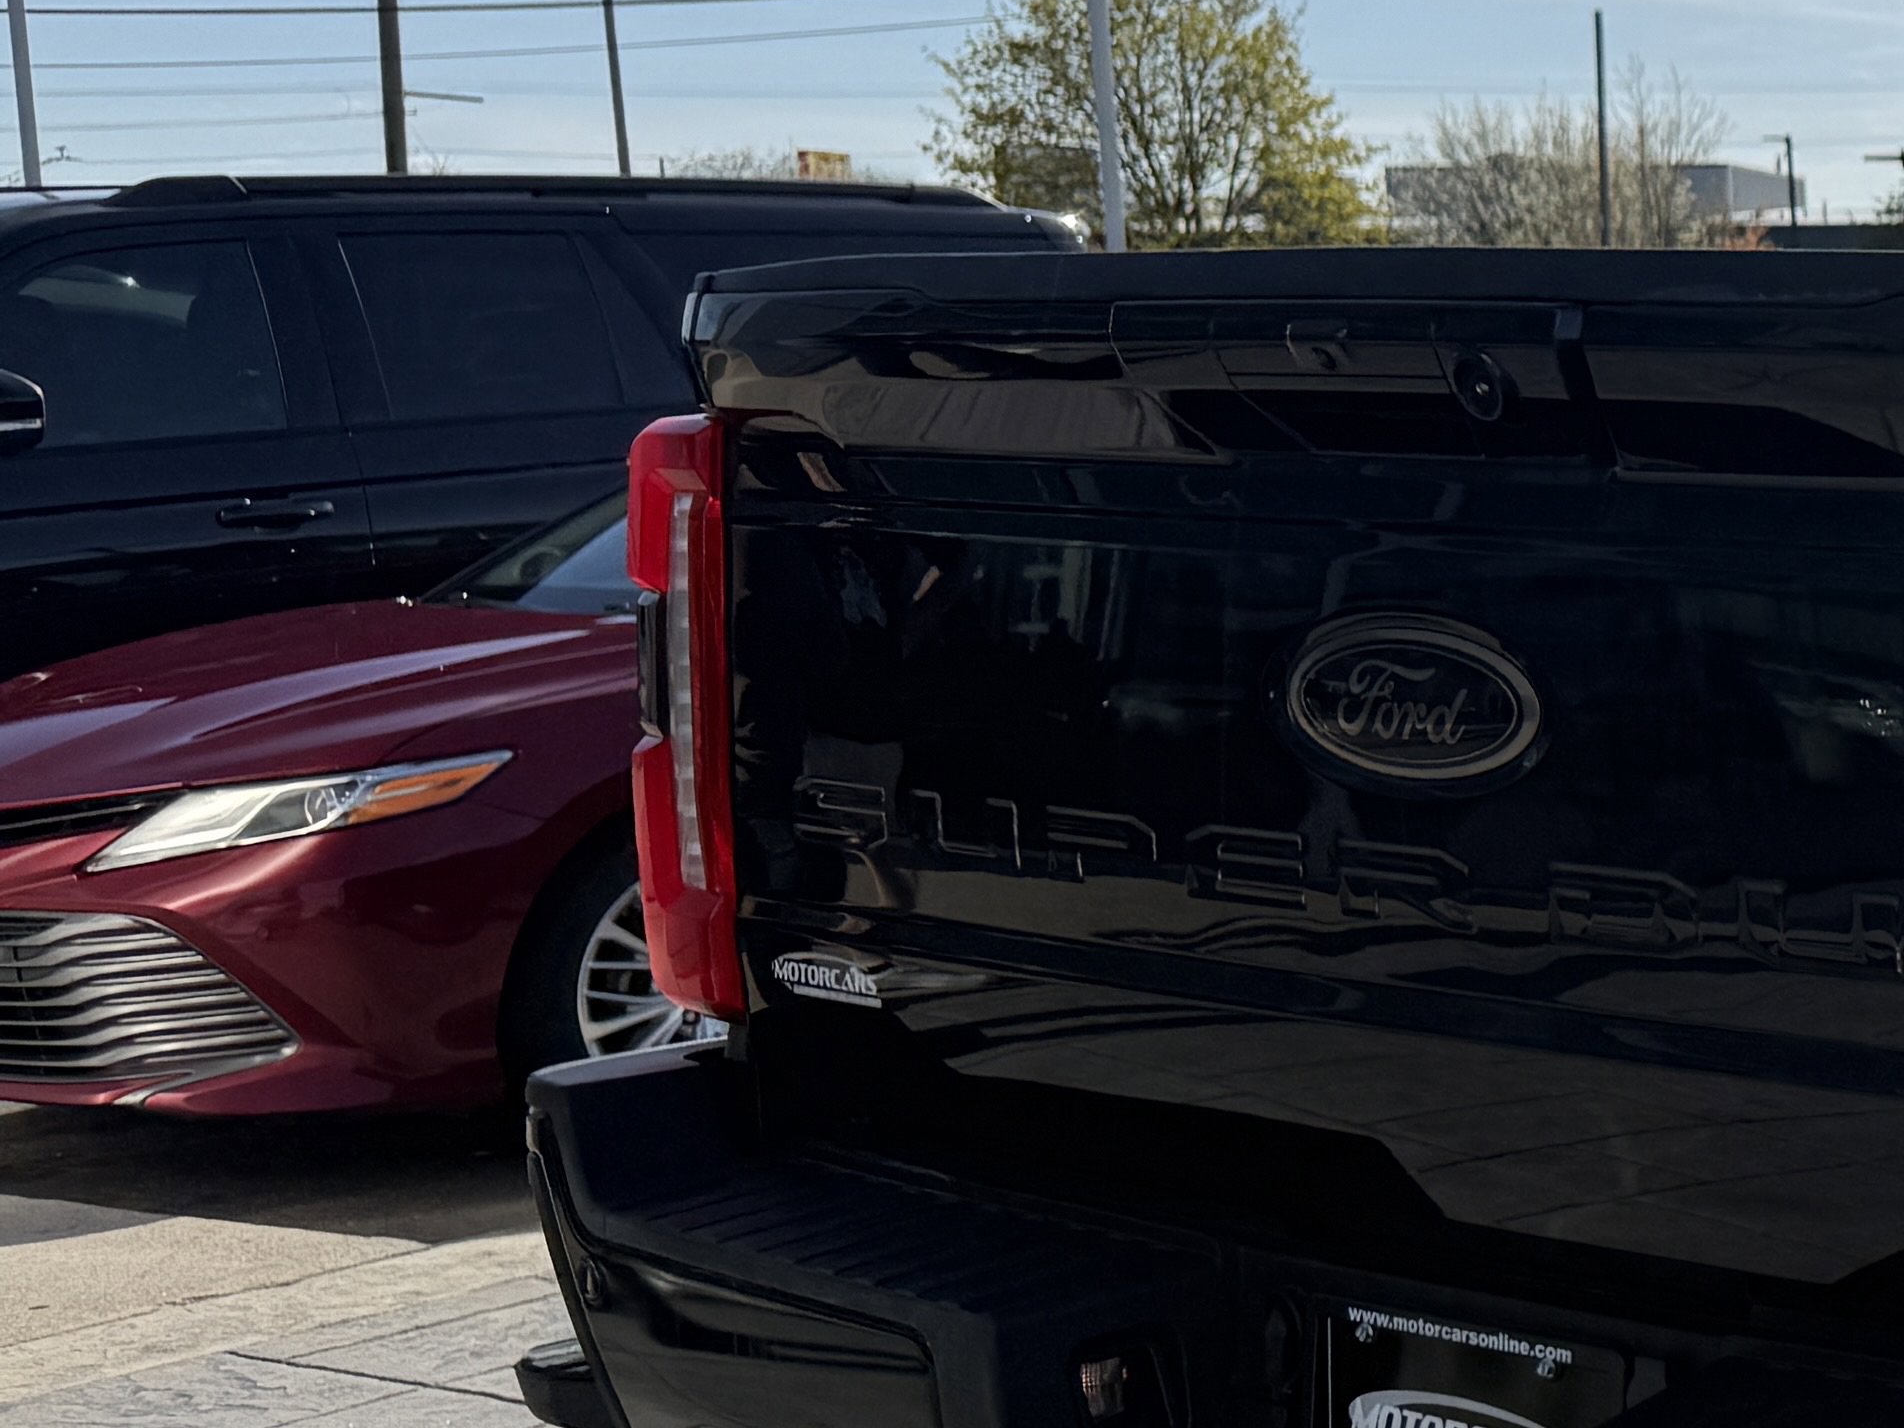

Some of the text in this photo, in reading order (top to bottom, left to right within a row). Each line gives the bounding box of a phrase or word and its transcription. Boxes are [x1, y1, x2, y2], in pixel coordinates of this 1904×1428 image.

[1337, 658, 1470, 746] Ford
[794, 775, 1479, 935] SUPER
[772, 956, 878, 997] MOTORCARS
[1348, 1305, 1573, 1365] www.motorcarsonline.com
